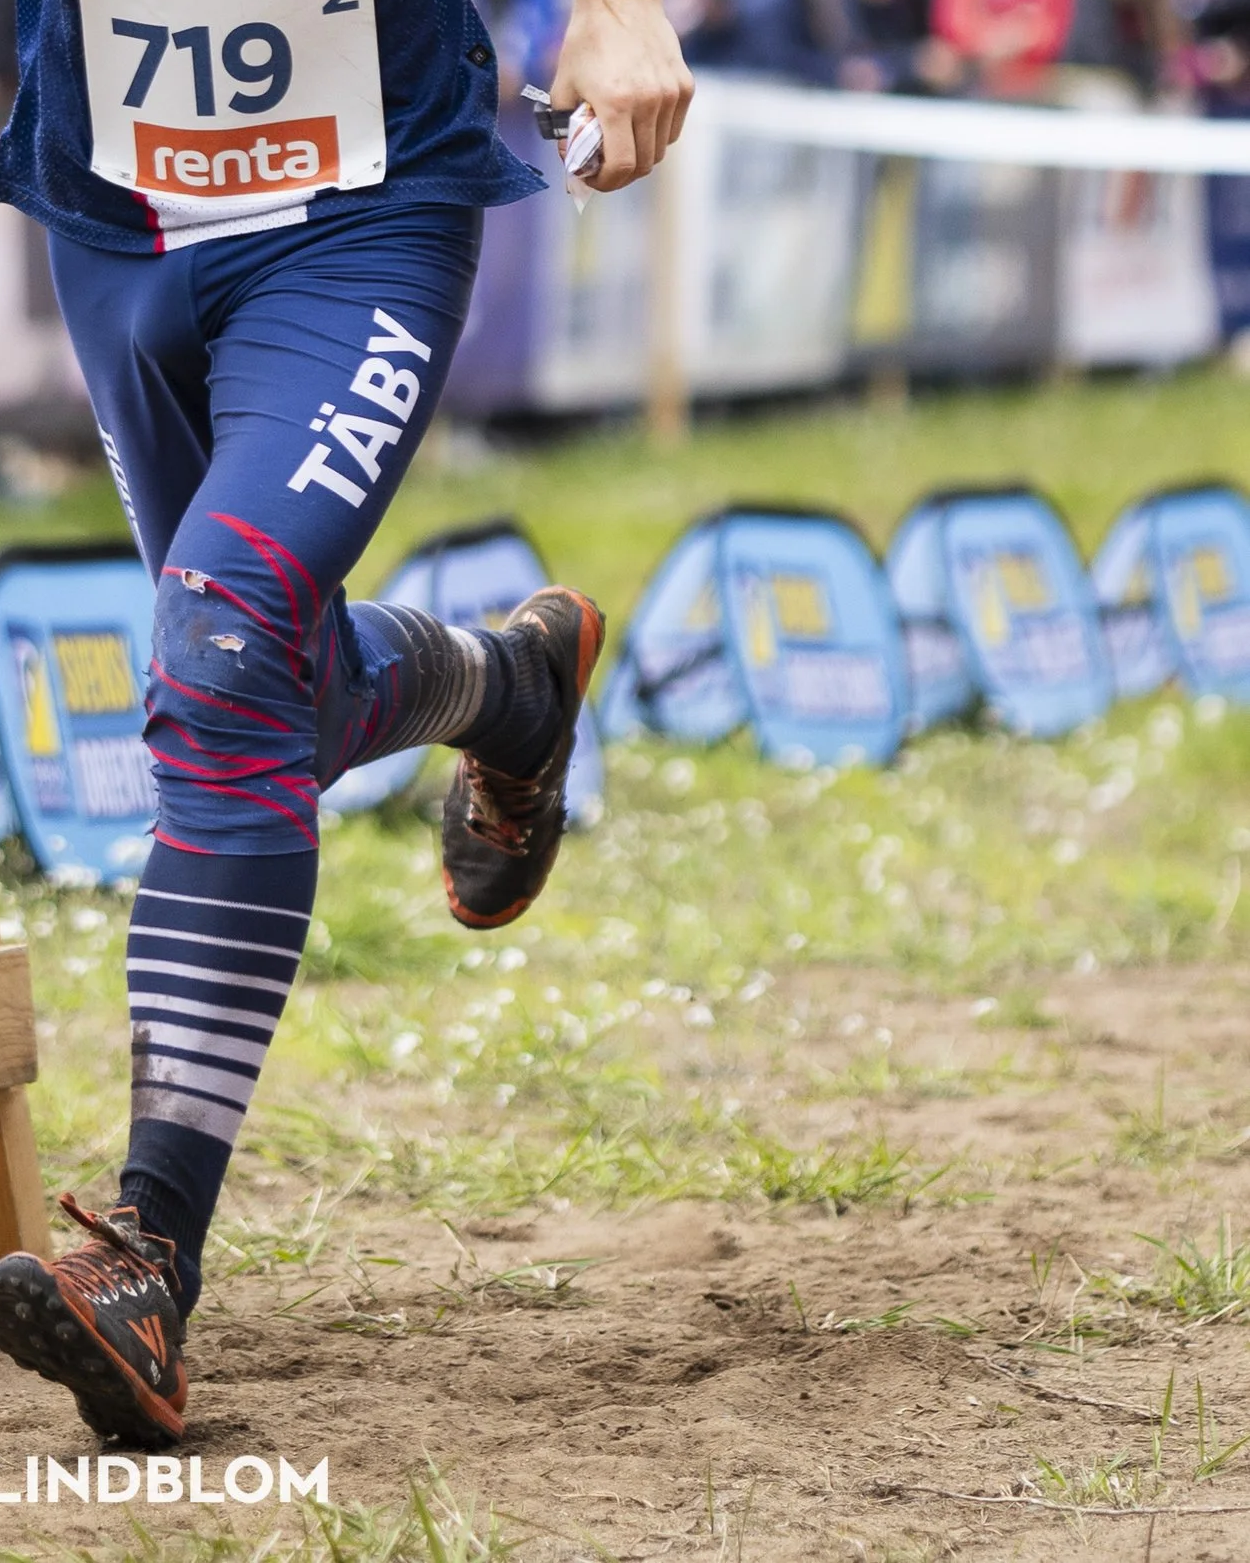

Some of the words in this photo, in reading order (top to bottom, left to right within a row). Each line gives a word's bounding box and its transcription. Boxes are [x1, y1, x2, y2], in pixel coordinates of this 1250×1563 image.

[111, 17, 293, 117] 719
[153, 137, 321, 187] renta
[287, 307, 432, 509] TÄBY
